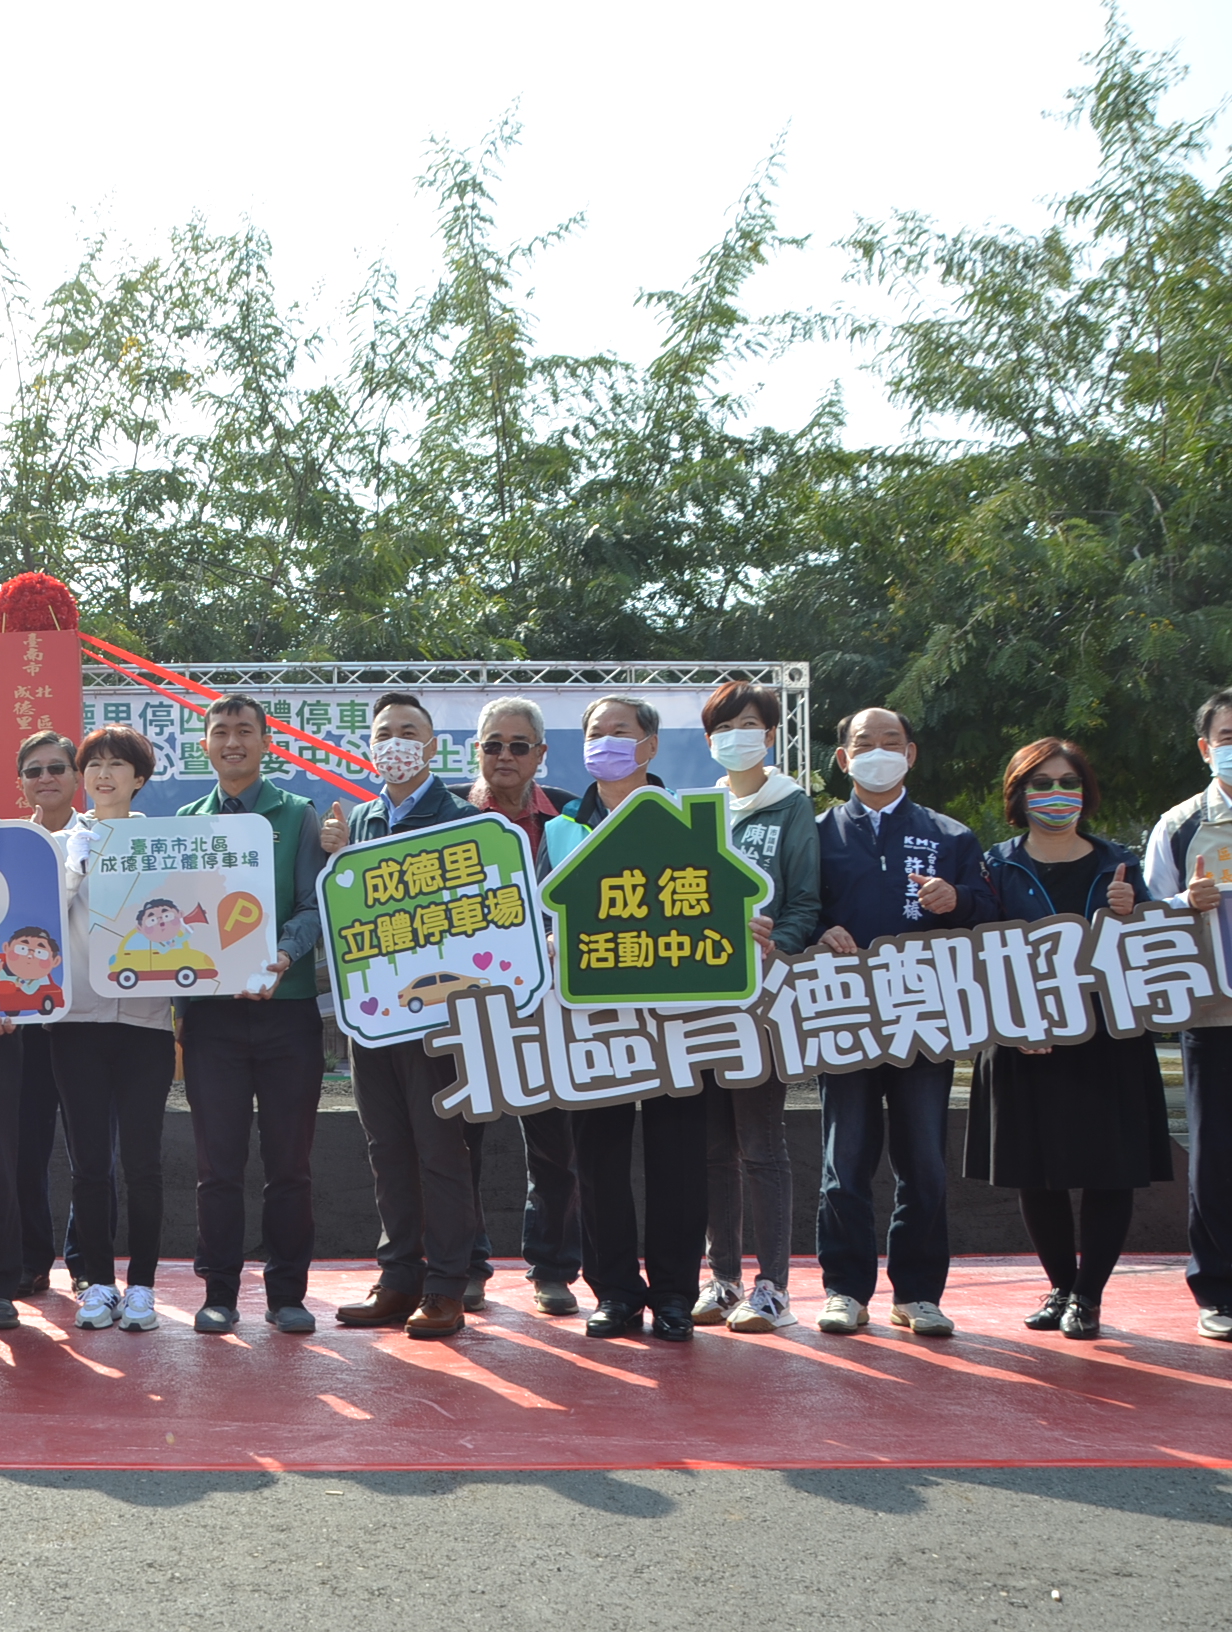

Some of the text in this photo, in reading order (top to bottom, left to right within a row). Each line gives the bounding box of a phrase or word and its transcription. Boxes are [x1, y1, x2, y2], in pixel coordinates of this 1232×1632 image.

[22, 633, 44, 677] 臺南市
[100, 850, 260, 873] 成德里立體停車場
[130, 835, 229, 856] 臺南市北區
[903, 835, 940, 850] KMT
[364, 842, 485, 906] 成德里
[597, 867, 711, 920] 成德
[223, 897, 261, 932] P
[340, 885, 525, 961] 立體停車場
[578, 928, 734, 970] 活動中心
